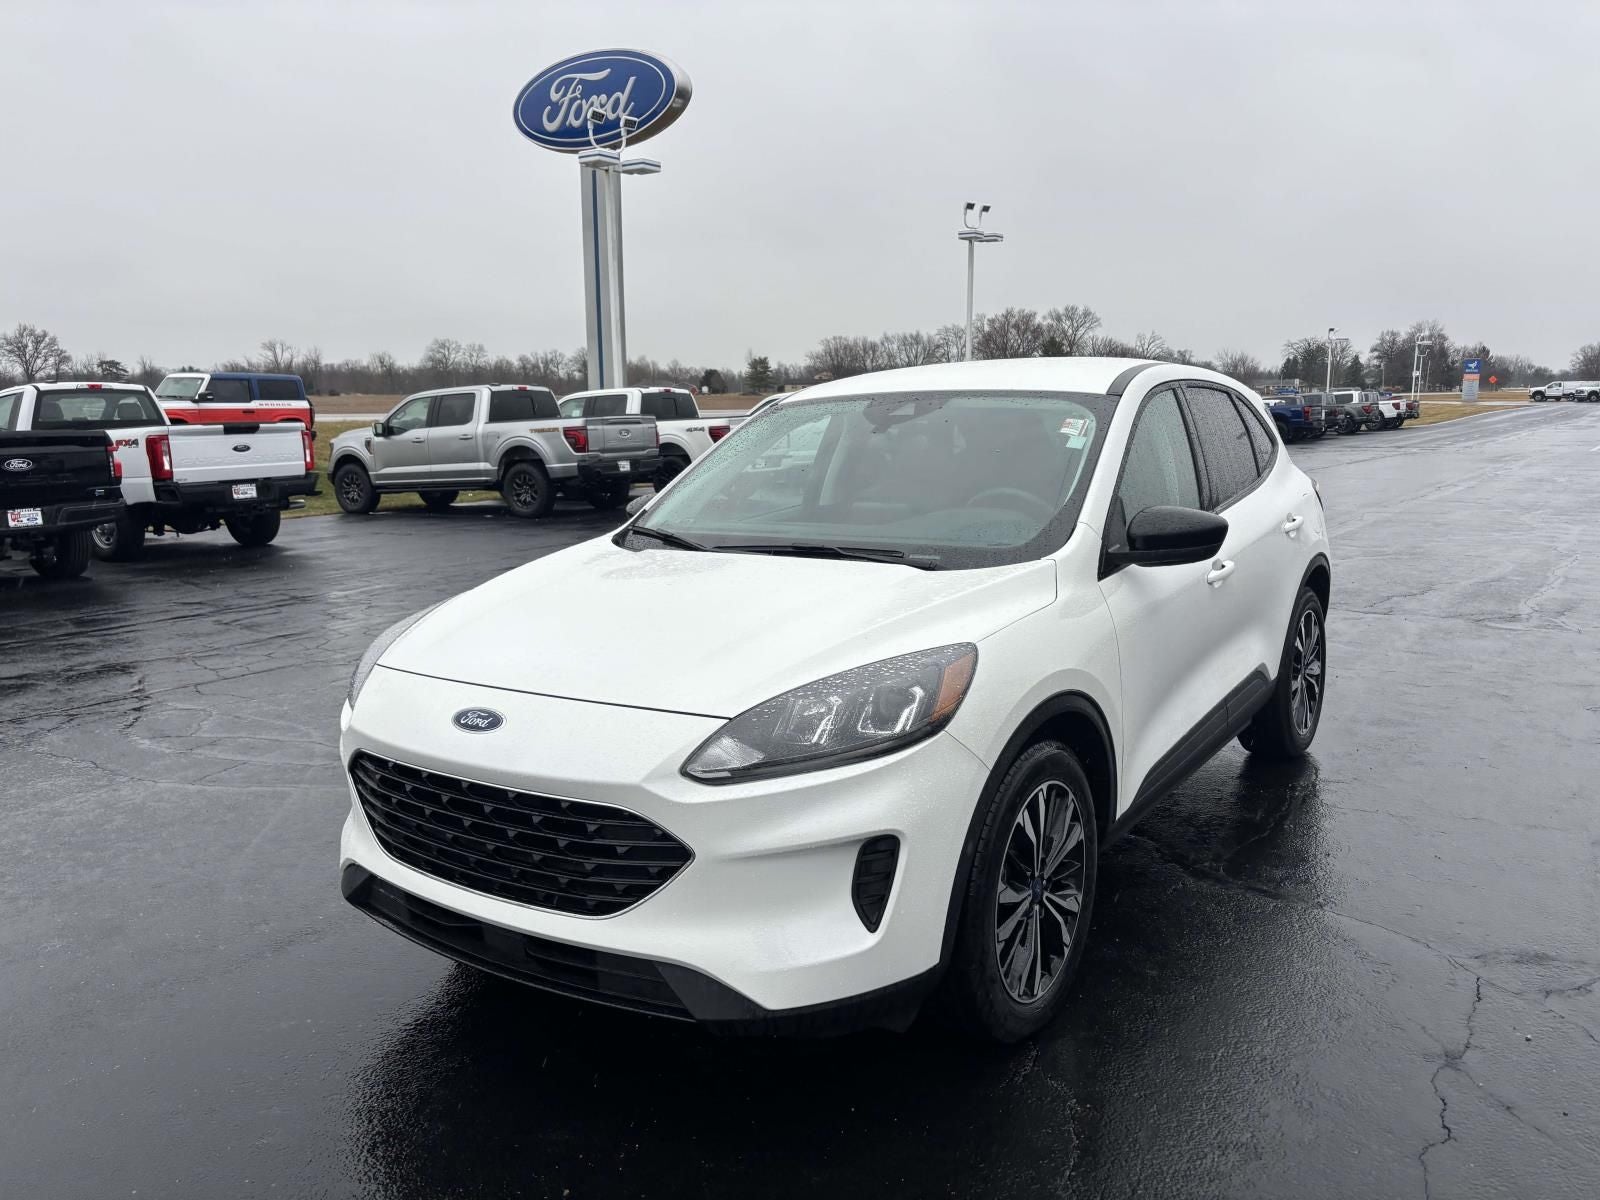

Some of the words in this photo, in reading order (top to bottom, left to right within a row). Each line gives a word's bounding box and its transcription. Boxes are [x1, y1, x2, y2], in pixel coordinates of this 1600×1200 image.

[542, 67, 637, 133] Ford
[9, 460, 28, 469] Ford
[460, 710, 493, 728] Ford
